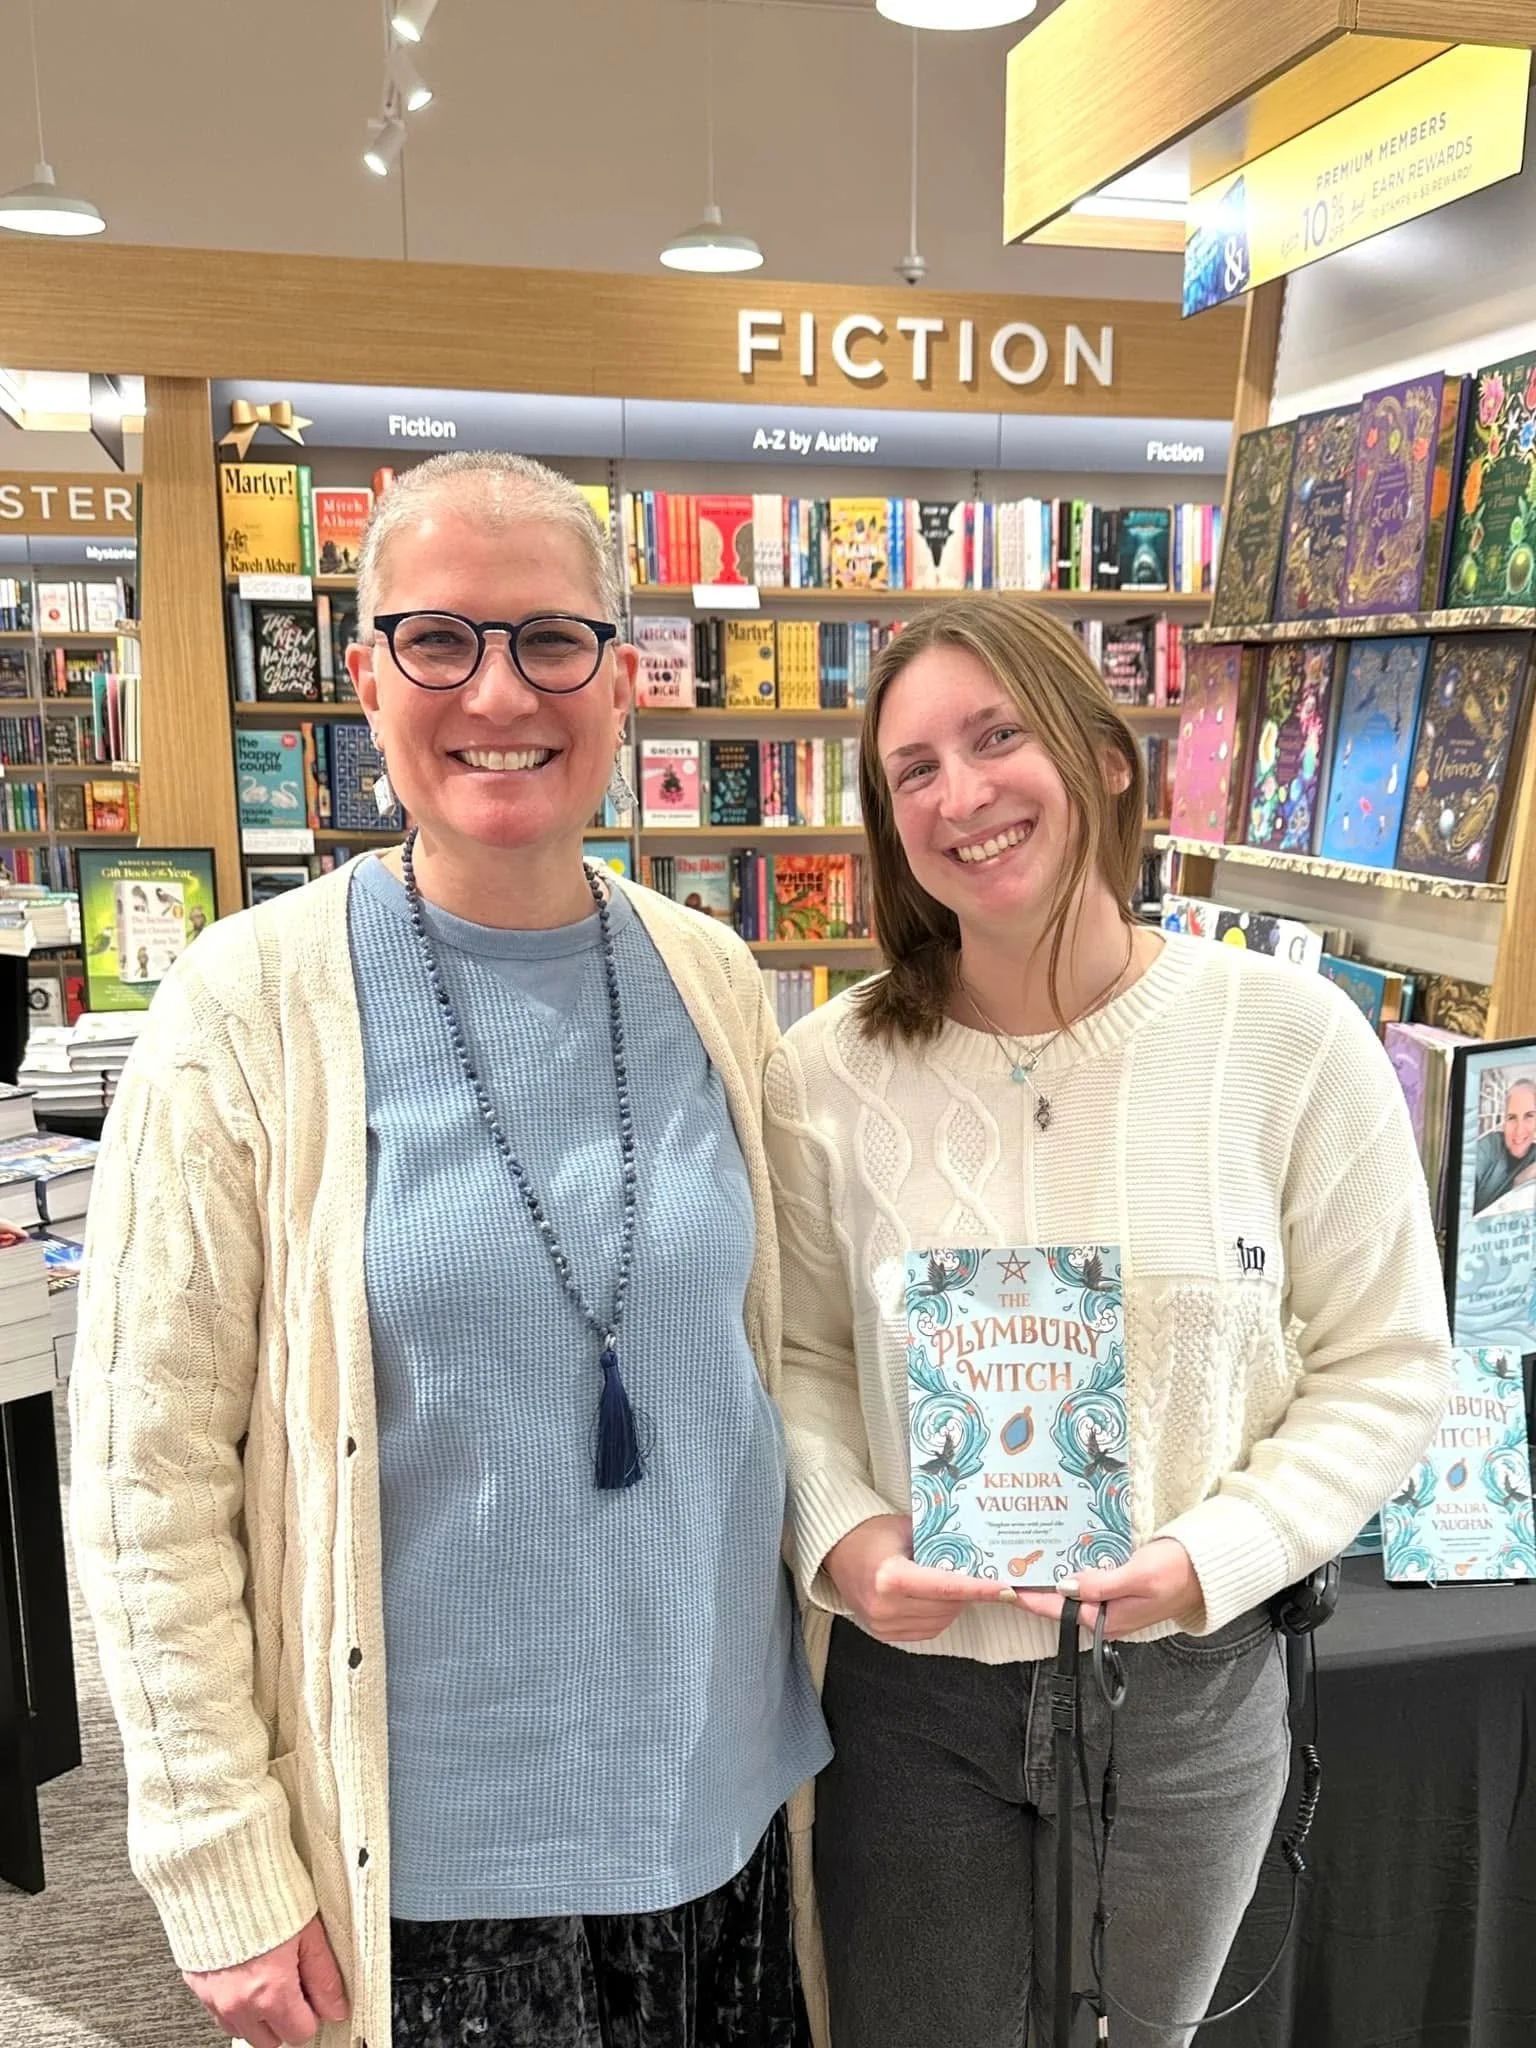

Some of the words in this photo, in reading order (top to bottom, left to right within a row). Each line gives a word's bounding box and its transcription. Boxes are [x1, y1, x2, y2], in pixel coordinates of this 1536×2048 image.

[1316, 149, 1373, 191] PREMIUM
[1379, 112, 1447, 161] MEMBERS
[1372, 168, 1405, 200] EARN
[1408, 136, 1473, 182] REWARDS
[1303, 200, 1329, 252] 10
[738, 309, 1114, 387] FICTION
[388, 415, 456, 438] Fiction
[752, 428, 786, 450] A-Z
[789, 429, 812, 455] by
[815, 429, 879, 453] Author
[1147, 441, 1205, 463] Fiction
[225, 468, 294, 501] Martyr!
[323, 498, 363, 513] Mitch
[230, 556, 263, 574] Kaveh
[265, 557, 297, 574] Akbar
[262, 613, 296, 636] THE
[727, 622, 774, 646] Martyr!
[273, 627, 316, 652] NEW
[238, 735, 258, 749] the
[239, 749, 281, 764] happy
[239, 760, 282, 775] couple
[1433, 745, 1483, 783] Universe
[101, 867, 122, 878] Gift
[998, 1293, 1030, 1308] THE
[931, 1314, 1101, 1367] PLYMBURY
[956, 1358, 1074, 1393] WITCH
[983, 1472, 1063, 1489] KENDRA
[976, 1495, 1069, 1512] VAUGHAN
[1435, 1503, 1489, 1515] KENDRA
[1431, 1519, 1493, 1531] VAUGHAN
